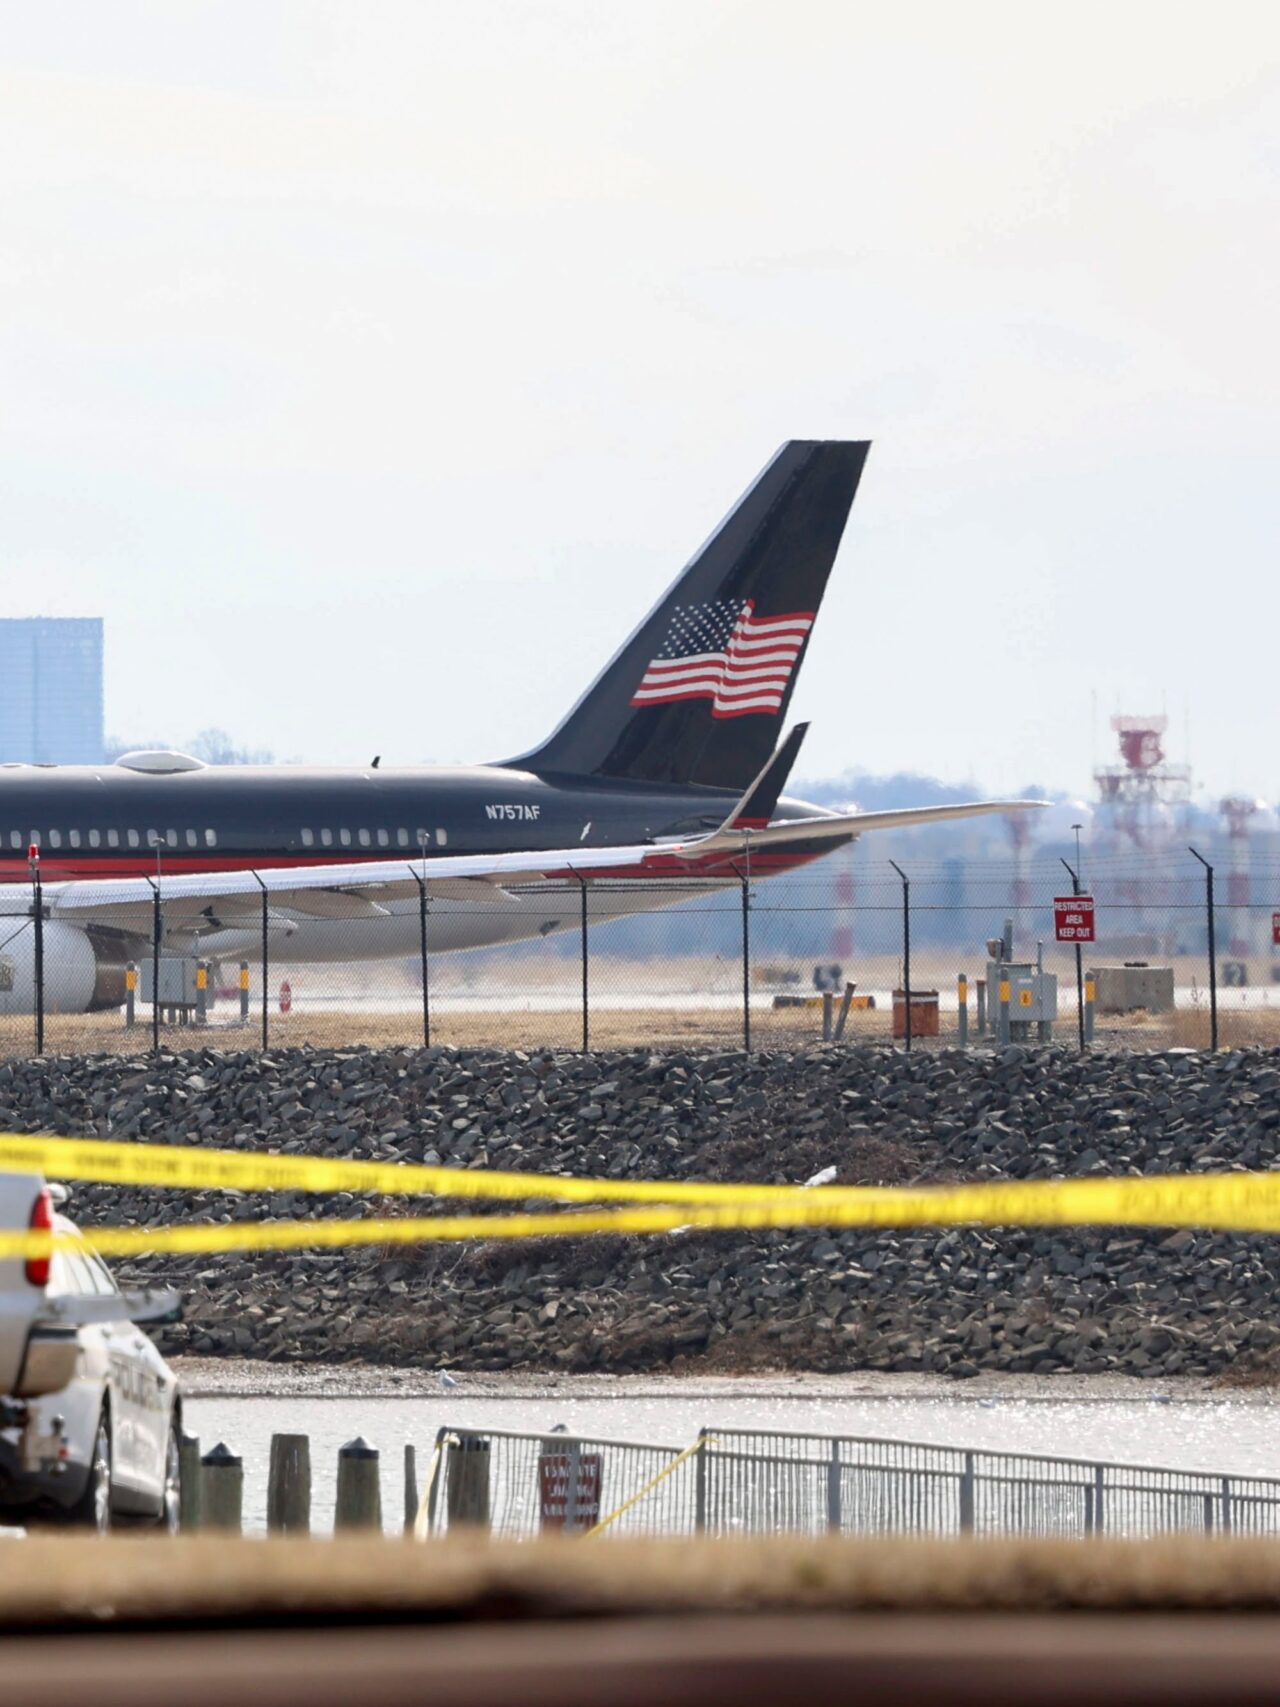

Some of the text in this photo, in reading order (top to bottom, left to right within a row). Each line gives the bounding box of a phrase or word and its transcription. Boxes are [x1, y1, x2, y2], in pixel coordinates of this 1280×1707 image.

[485, 805, 540, 820] N757AF
[1055, 901, 1093, 911] RESTRICTED
[1065, 914, 1083, 924] AREA
[1059, 927, 1090, 938] KEEP OUT
